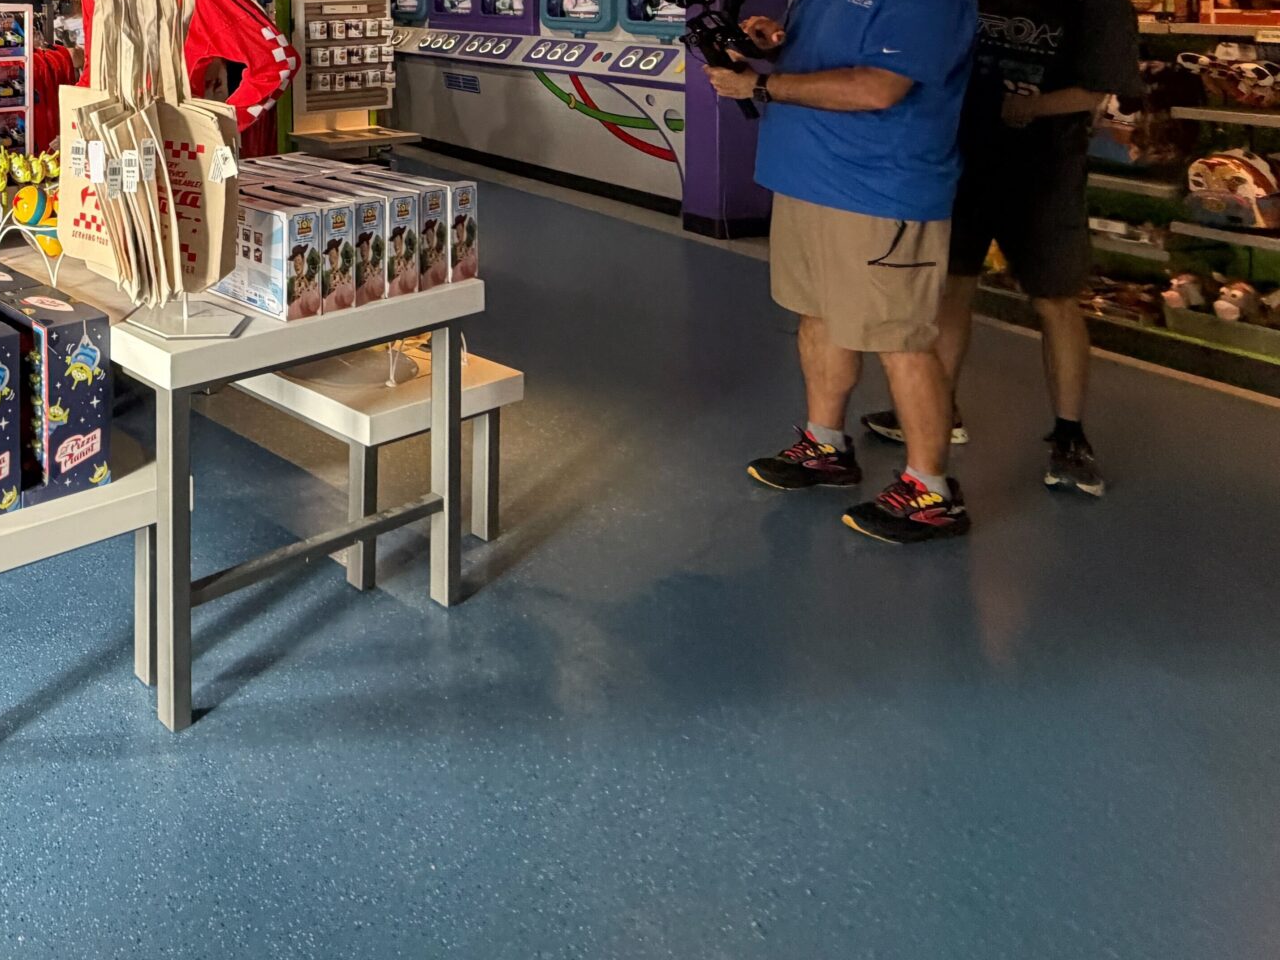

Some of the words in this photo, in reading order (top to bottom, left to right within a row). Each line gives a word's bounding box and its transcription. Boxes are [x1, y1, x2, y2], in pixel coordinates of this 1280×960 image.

[71, 229, 96, 242] SERVING
[67, 433, 97, 452] Pizza
[62, 442, 96, 468] Planet
